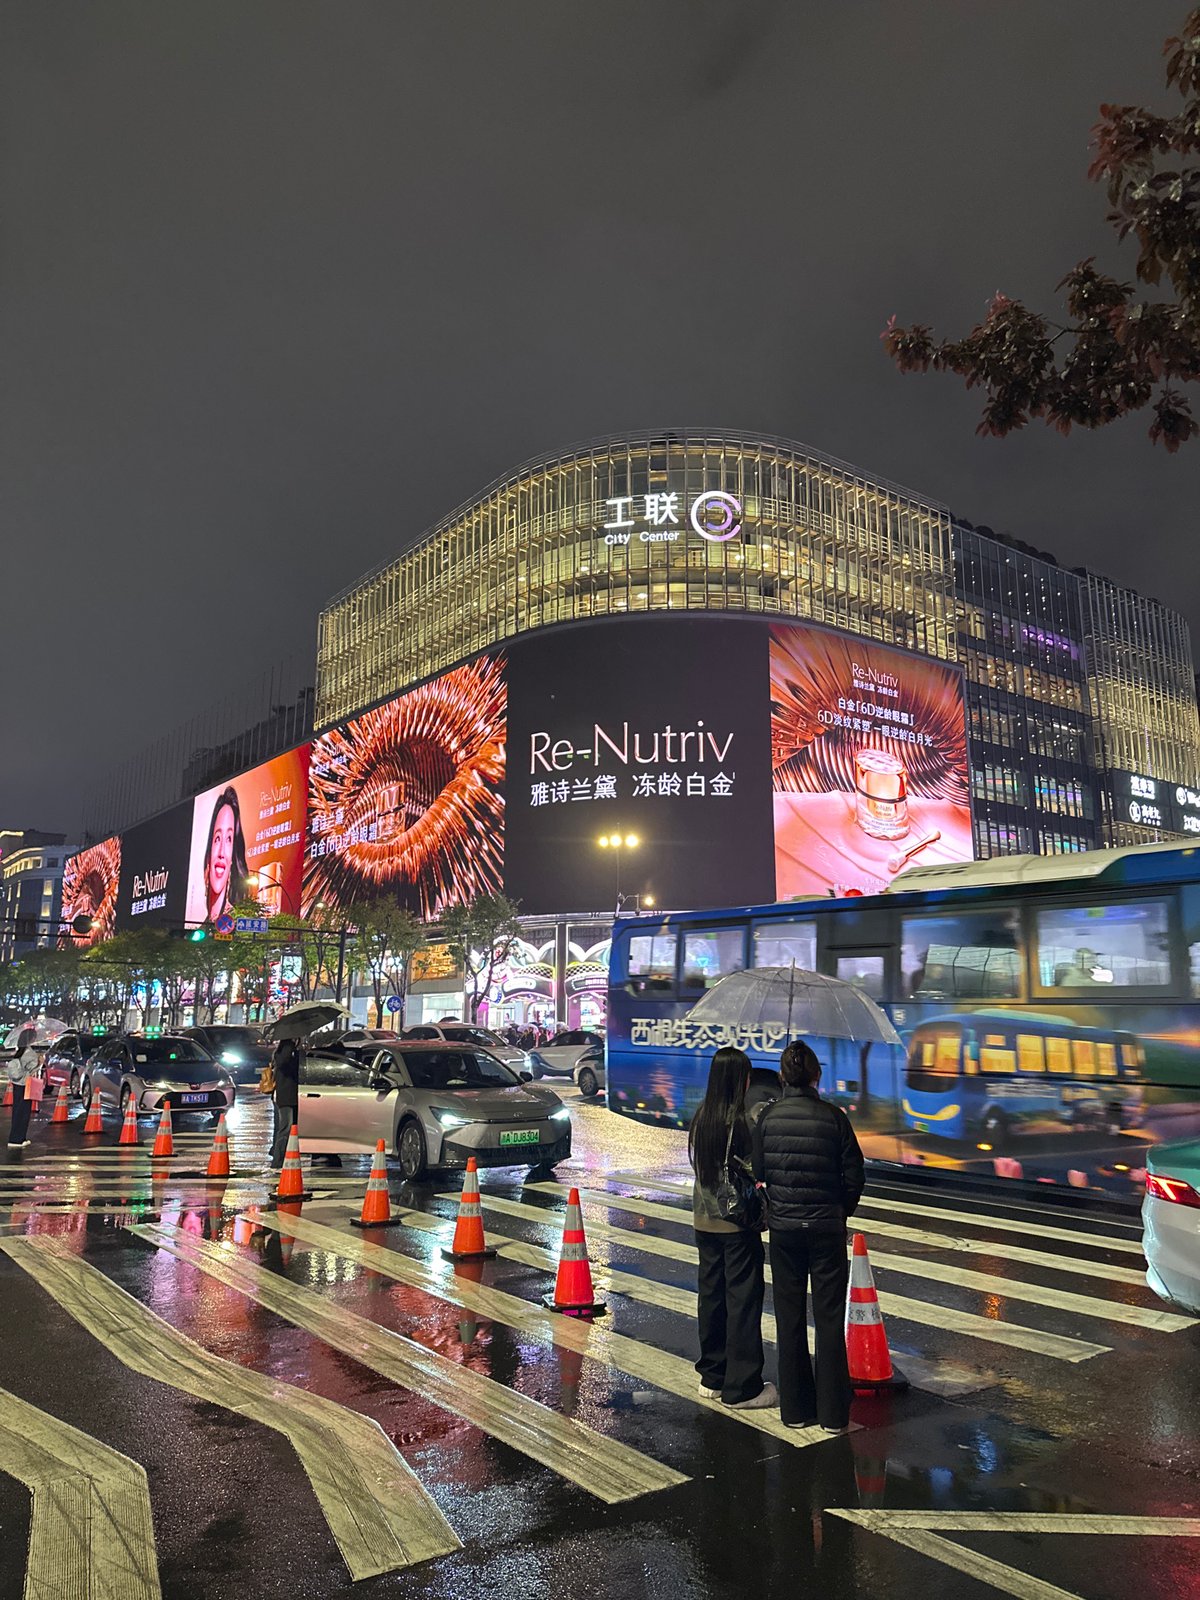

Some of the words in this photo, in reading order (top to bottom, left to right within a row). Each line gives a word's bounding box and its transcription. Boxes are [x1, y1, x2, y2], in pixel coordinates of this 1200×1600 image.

[603, 491, 679, 529] 工联
[604, 533, 631, 545] City
[639, 530, 680, 542] Center
[852, 662, 899, 688] Re-Nutriv
[530, 720, 734, 774] Re-Nutriv
[530, 774, 617, 807] 雅诗兰黛
[132, 866, 169, 899] Re-Nutriv
